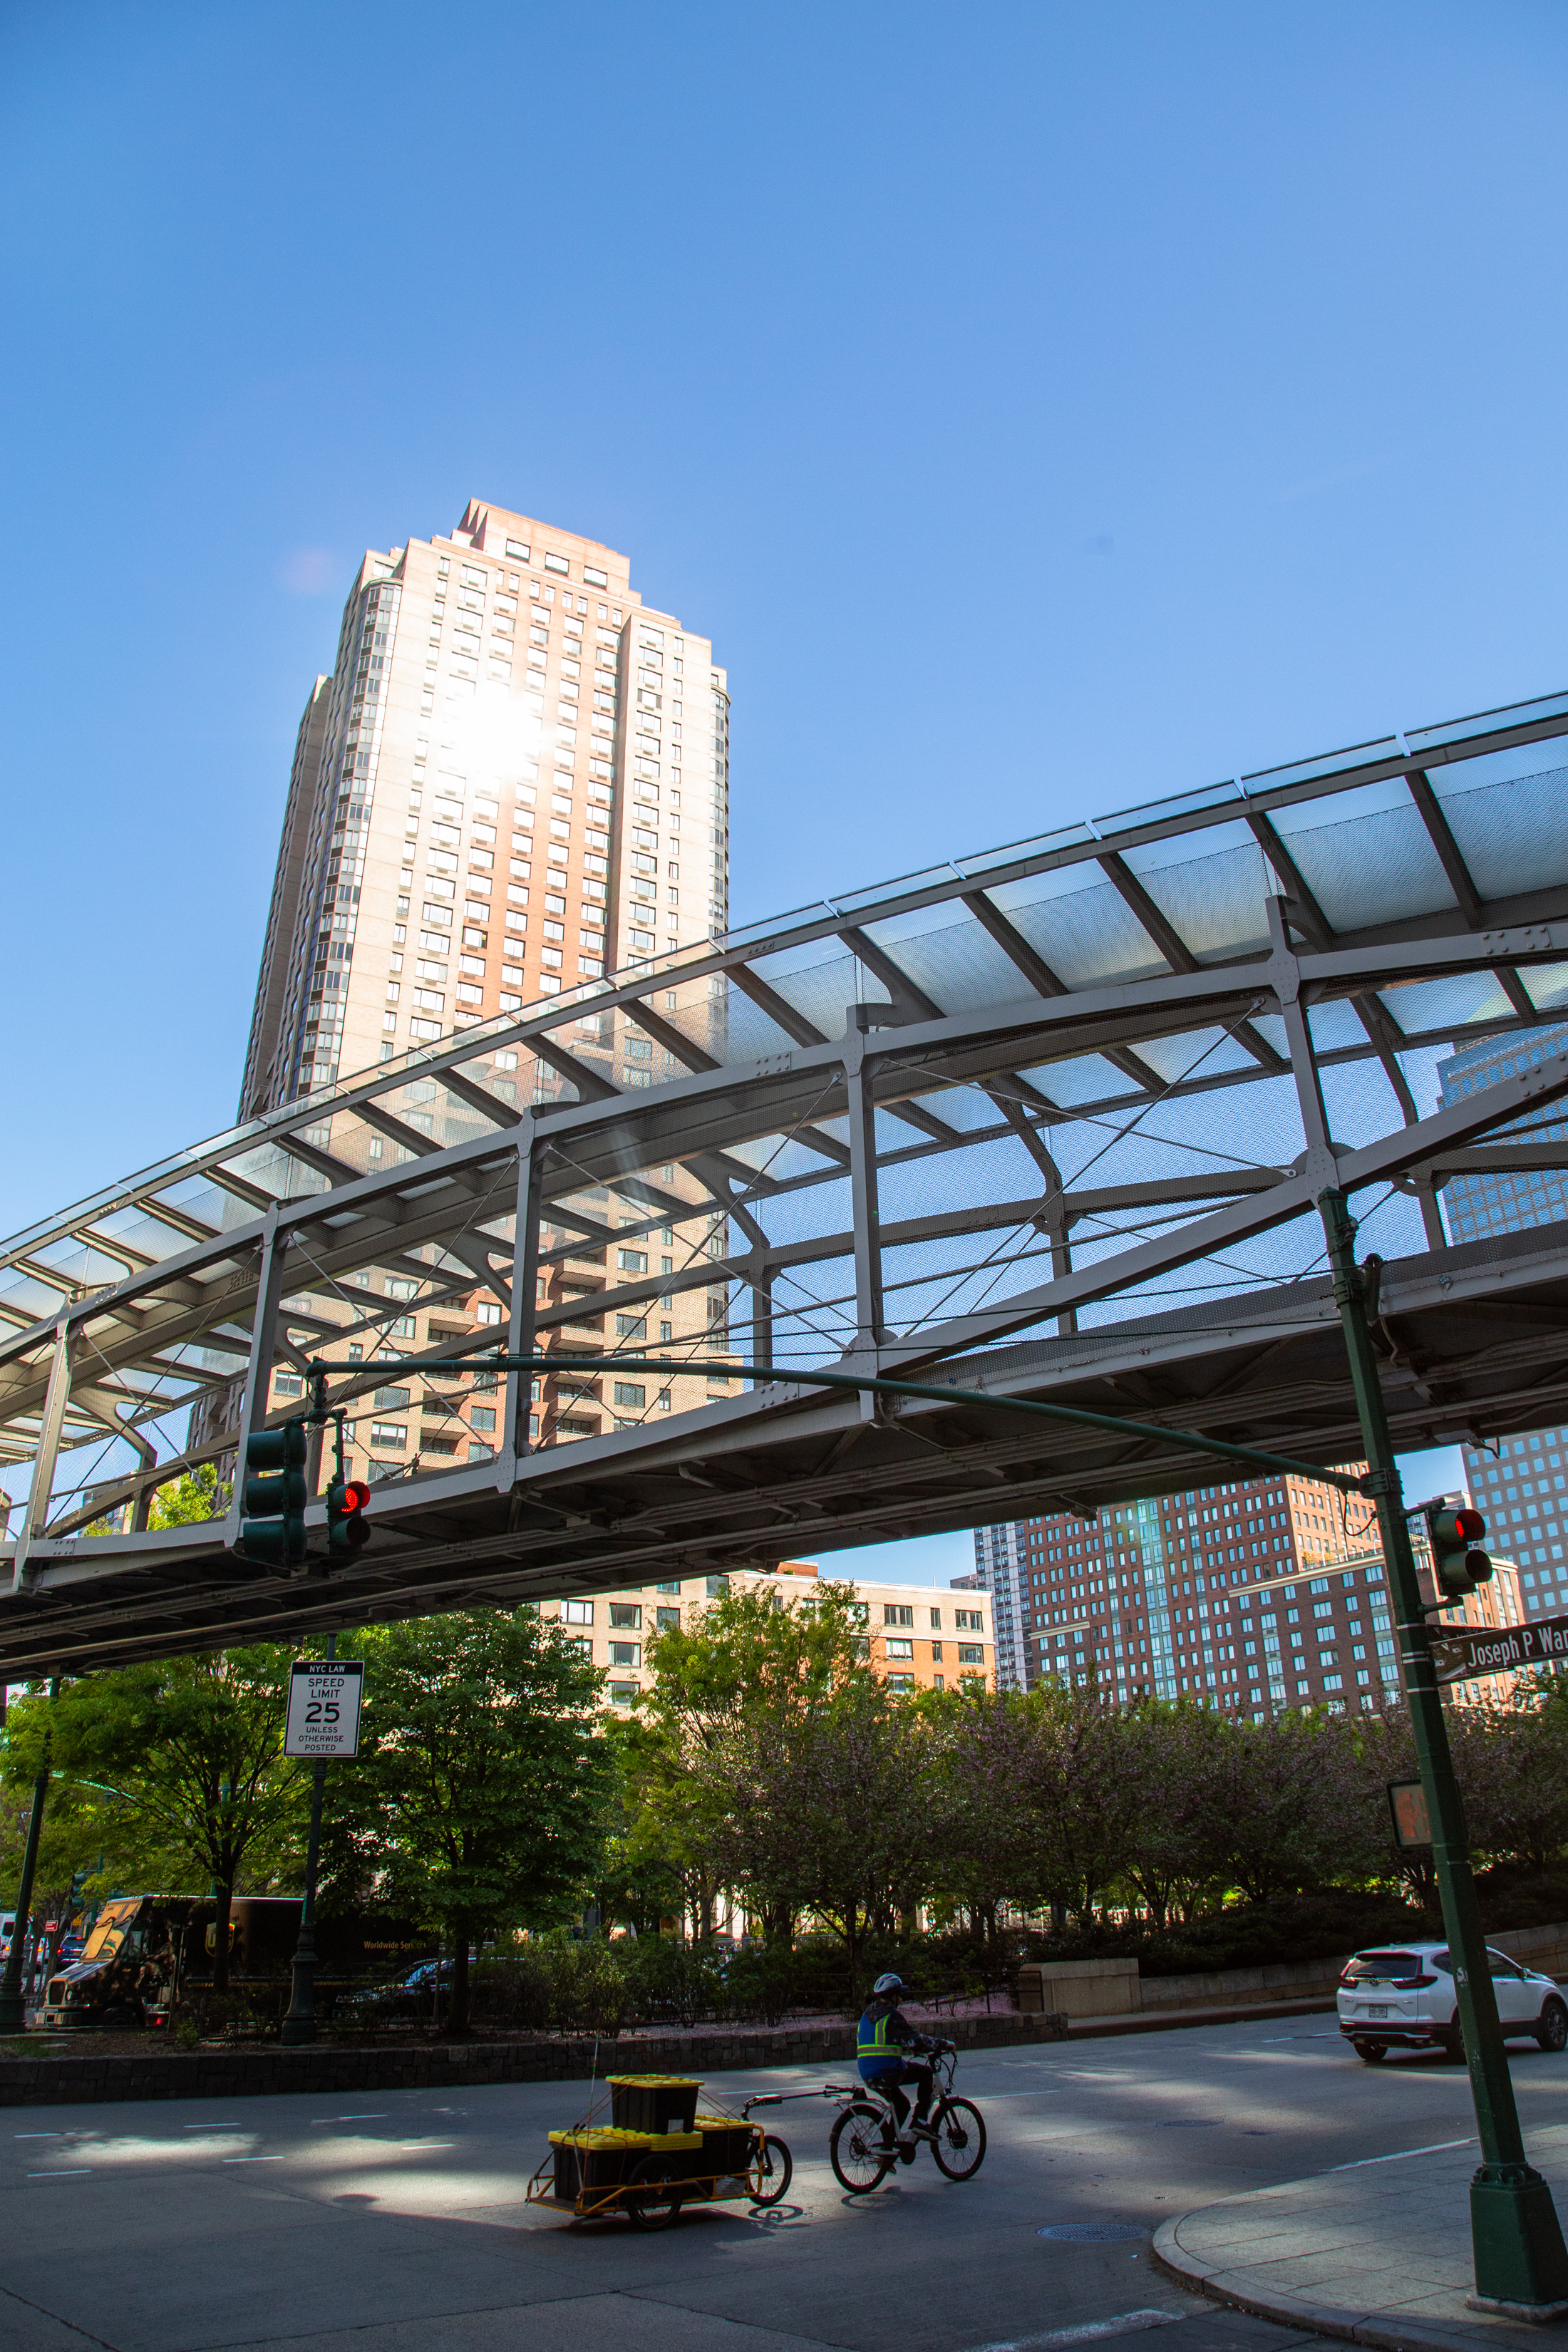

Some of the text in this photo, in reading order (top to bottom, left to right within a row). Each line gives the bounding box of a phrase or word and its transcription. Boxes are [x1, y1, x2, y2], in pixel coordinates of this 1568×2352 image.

[1468, 1634, 1520, 1667] Joseph
[1522, 1631, 1533, 1656] P
[308, 1678, 345, 1687] SPEED
[311, 1689, 341, 1698] LIMIT
[305, 1701, 340, 1723] 25
[364, 1940, 399, 1949] Worldwide
